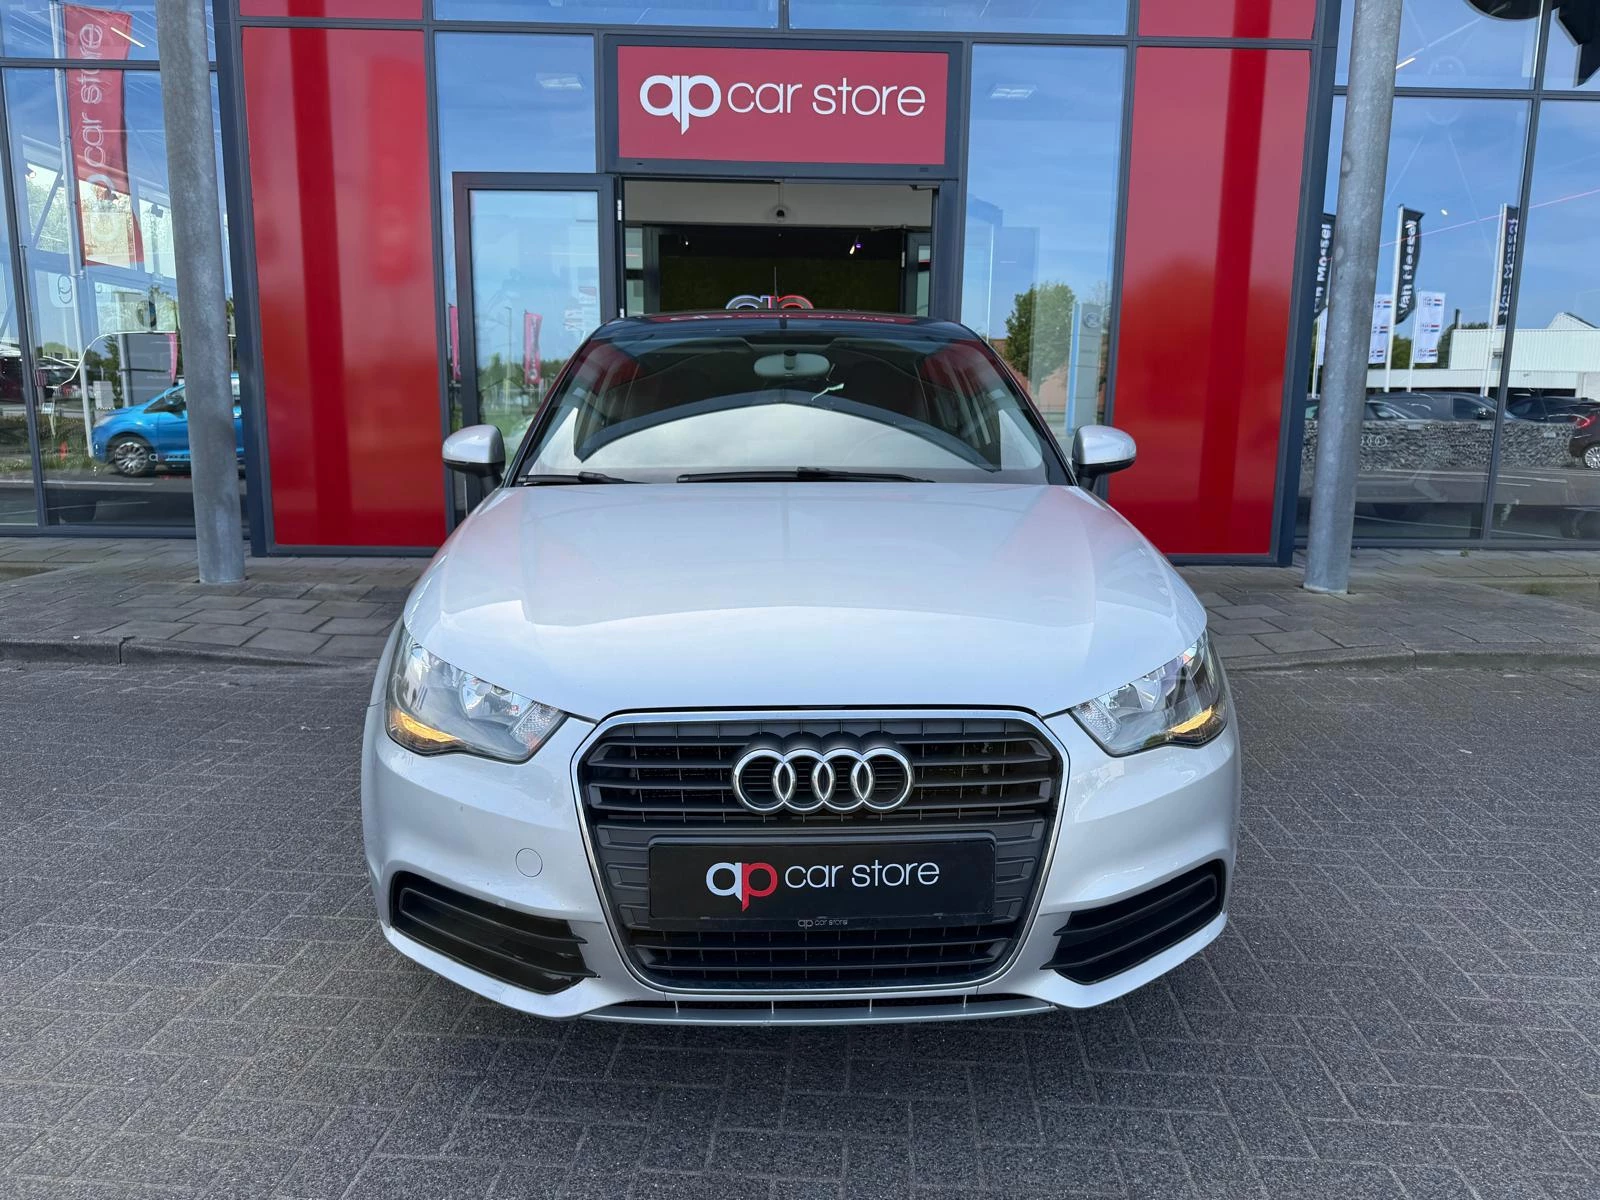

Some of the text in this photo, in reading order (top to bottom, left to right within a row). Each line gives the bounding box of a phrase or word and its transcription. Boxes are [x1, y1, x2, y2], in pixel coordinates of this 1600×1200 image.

[639, 75, 926, 135] ap car store
[81, 111, 106, 168] car
[705, 859, 940, 912] ap car store
[797, 919, 814, 930] ap
